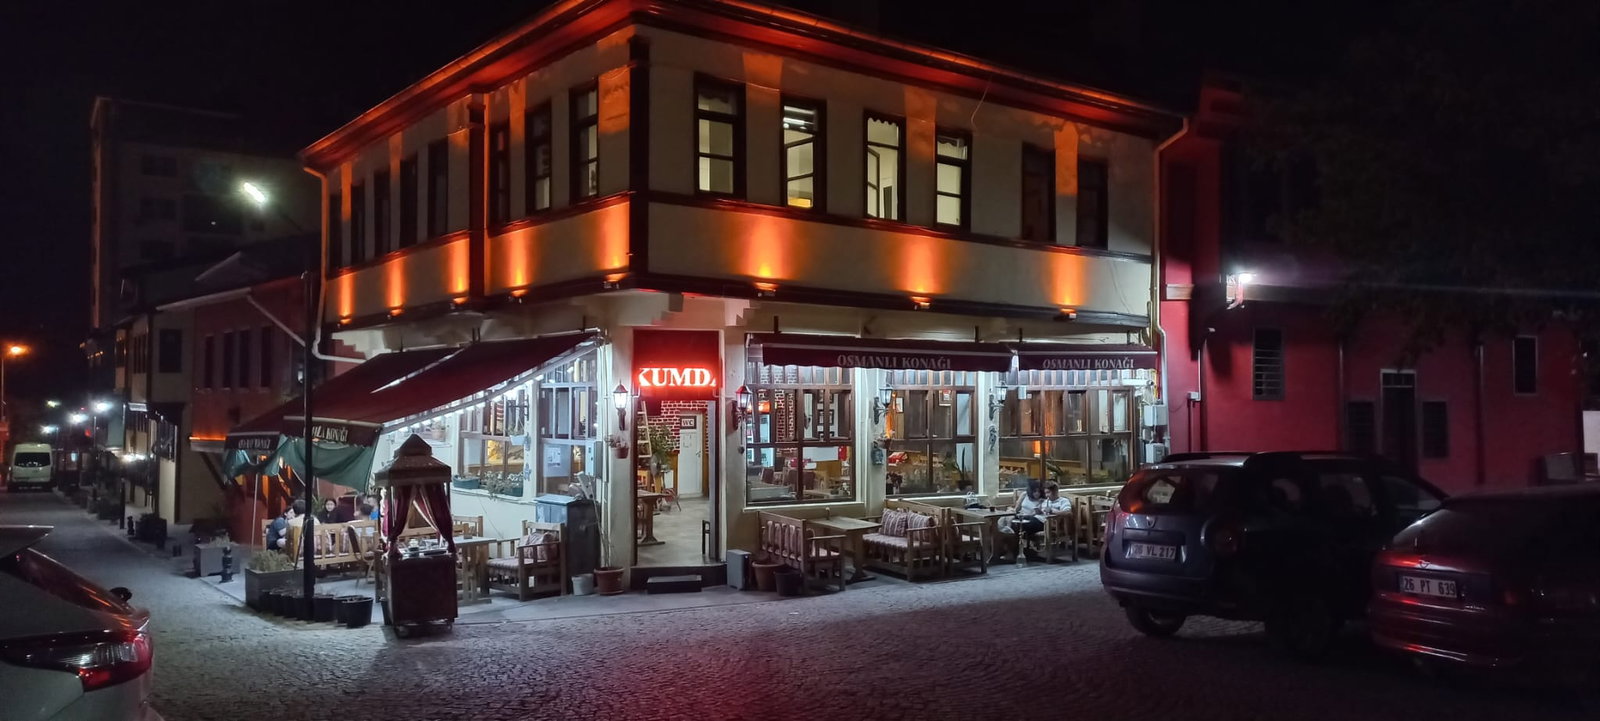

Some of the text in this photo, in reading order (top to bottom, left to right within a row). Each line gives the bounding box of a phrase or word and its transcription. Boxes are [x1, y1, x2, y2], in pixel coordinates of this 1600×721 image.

[837, 354, 951, 369] OSMANLI KONAĞI
[1042, 356, 1135, 369] OSMANLI KONAĞI
[1147, 546, 1156, 556] VL
[1160, 548, 1174, 558] 217
[1404, 578, 1456, 594] 26 PT 639
